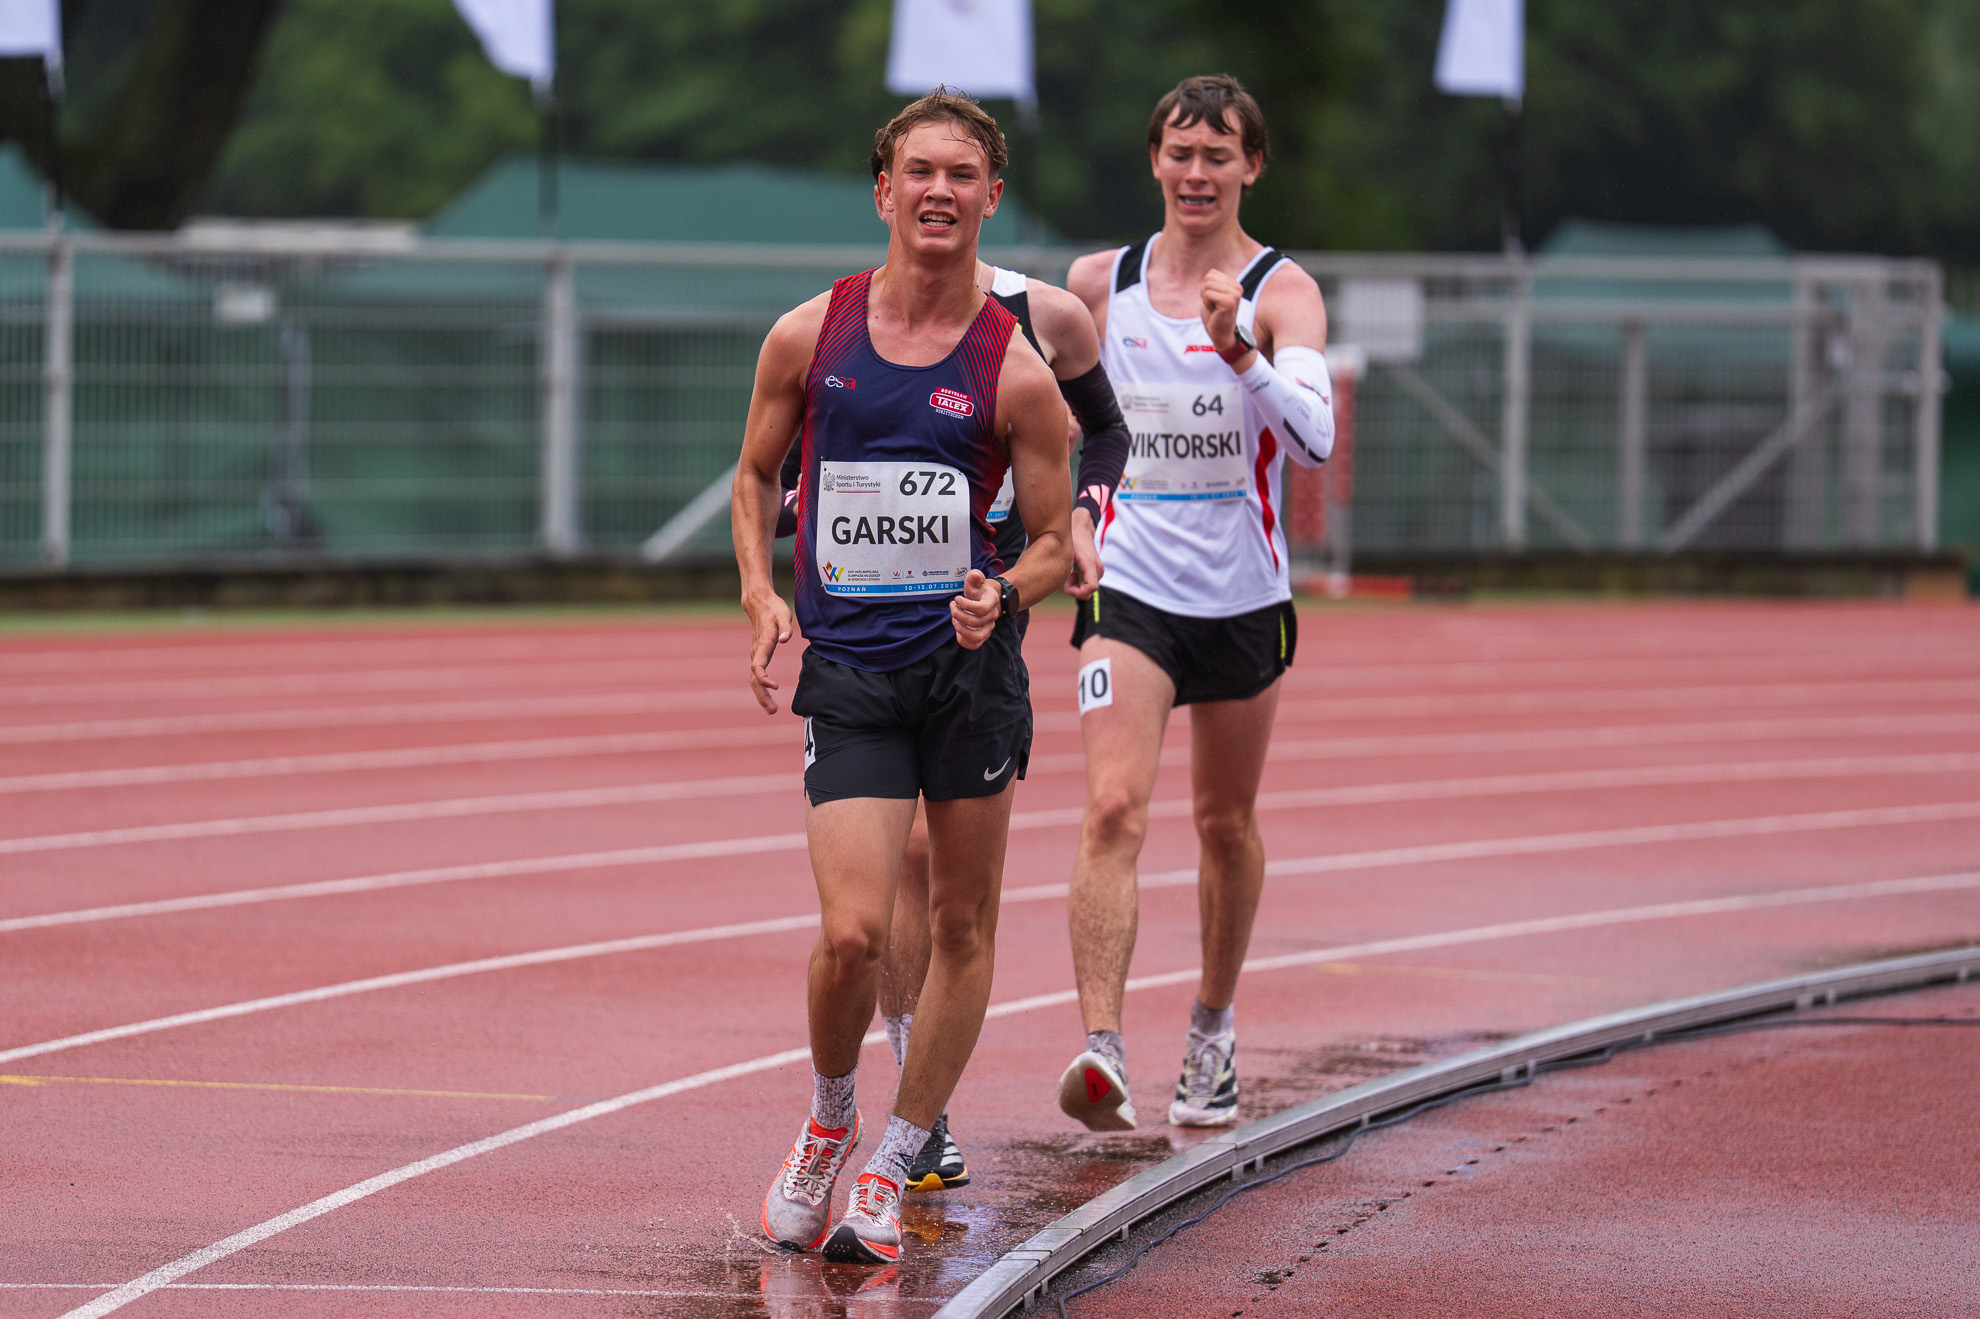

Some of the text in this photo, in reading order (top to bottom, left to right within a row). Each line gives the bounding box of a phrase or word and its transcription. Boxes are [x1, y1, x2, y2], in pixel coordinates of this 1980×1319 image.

[935, 395, 970, 412] TALEX
[1192, 394, 1224, 416] 64
[856, 481, 881, 489] Turystyki
[899, 470, 956, 496] 672
[831, 515, 949, 545] GARSKI
[1079, 667, 1108, 704] 10
